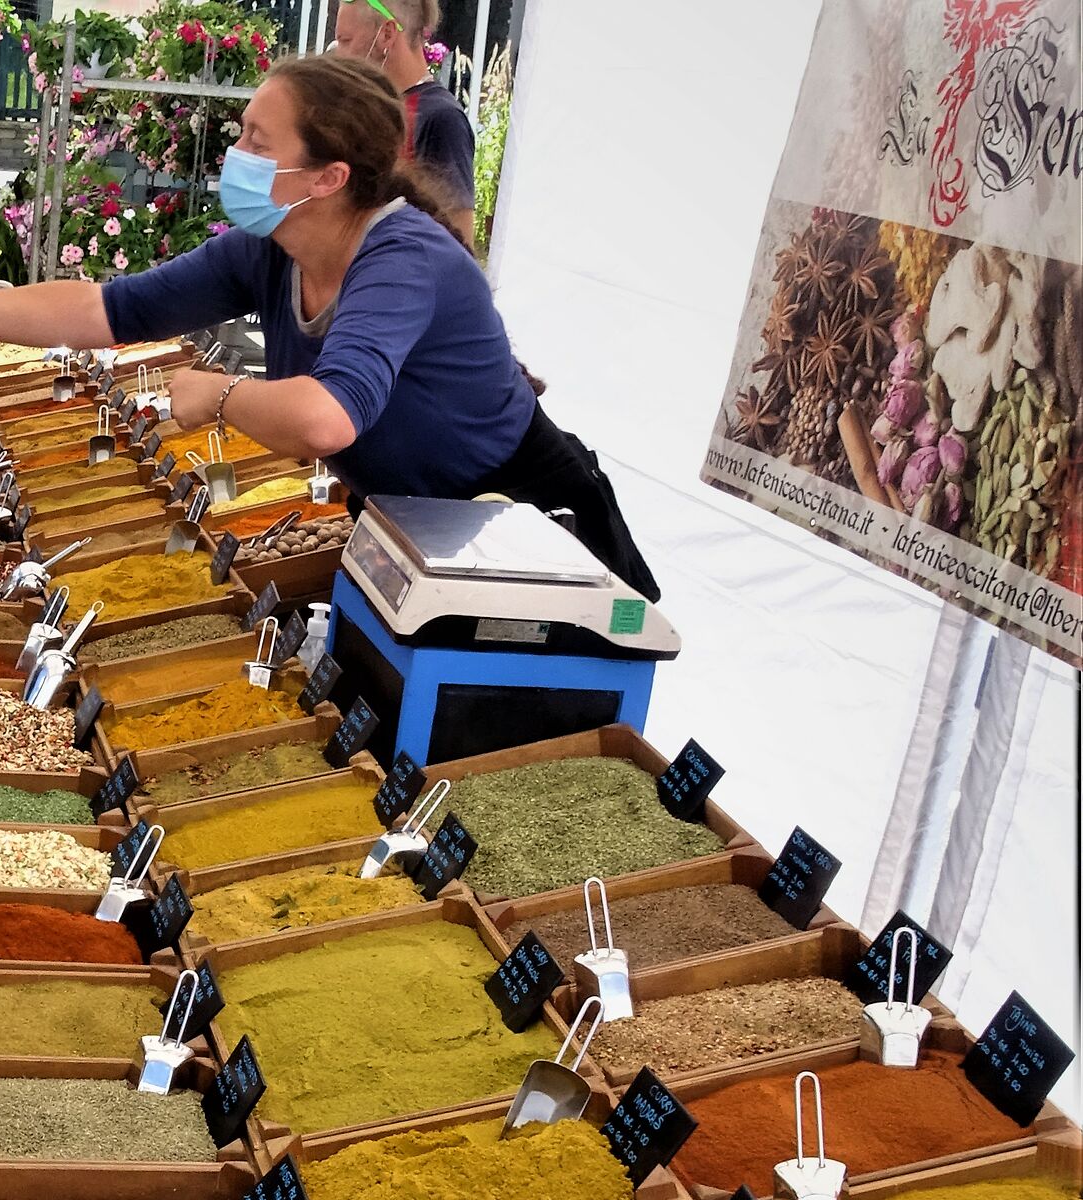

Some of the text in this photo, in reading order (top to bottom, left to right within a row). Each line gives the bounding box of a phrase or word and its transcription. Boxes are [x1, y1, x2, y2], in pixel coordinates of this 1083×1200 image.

[705, 450, 1083, 640] www.lafeniceoccitana.it lafeniceoccitana@liber
[531, 944, 548, 966] CURRY
[633, 1093, 664, 1130] MADRAS
[651, 1085, 676, 1117] CURRY
[255, 1183, 263, 1194] 50
